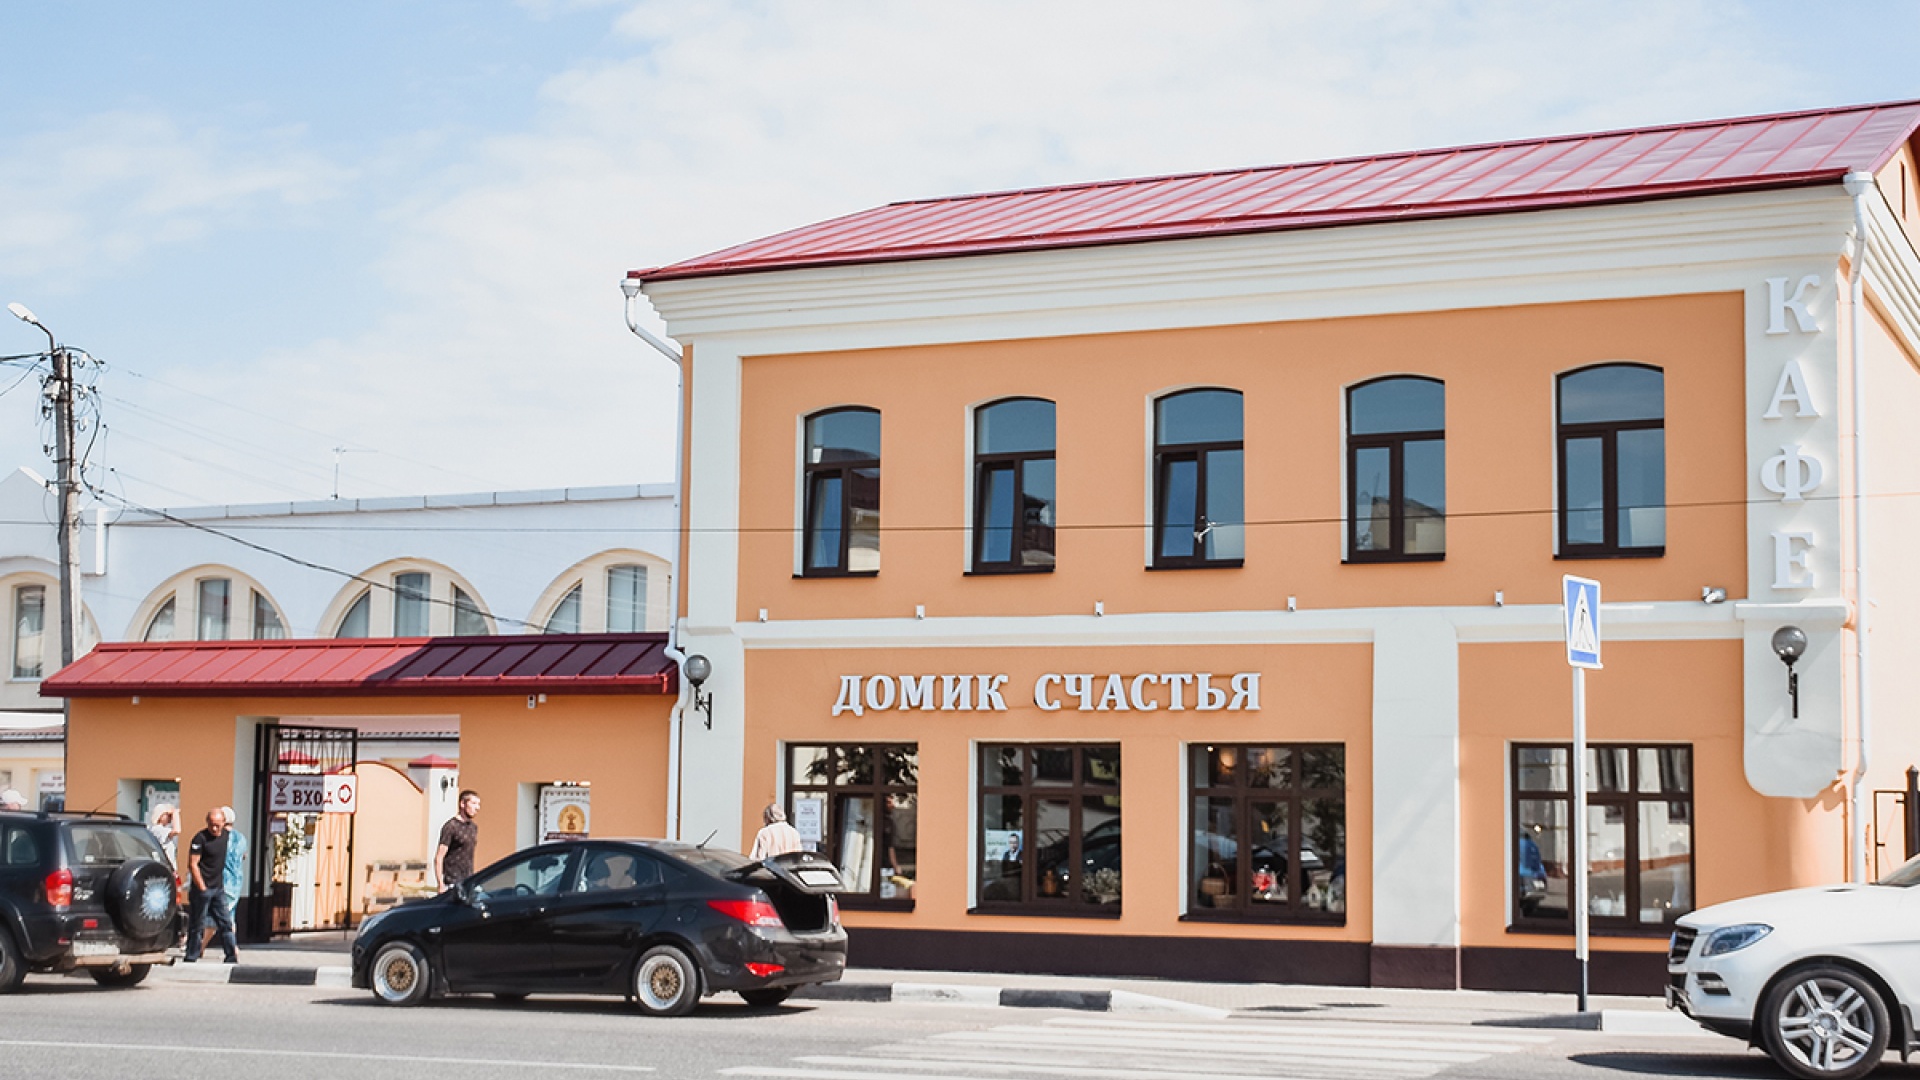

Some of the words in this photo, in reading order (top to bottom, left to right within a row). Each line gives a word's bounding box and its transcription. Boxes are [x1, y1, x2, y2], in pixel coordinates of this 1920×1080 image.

[1760, 274, 1823, 590] КАФЕ
[832, 674, 1009, 717] ДОМИК
[1034, 672, 1262, 712] СЧАСТЬЯ
